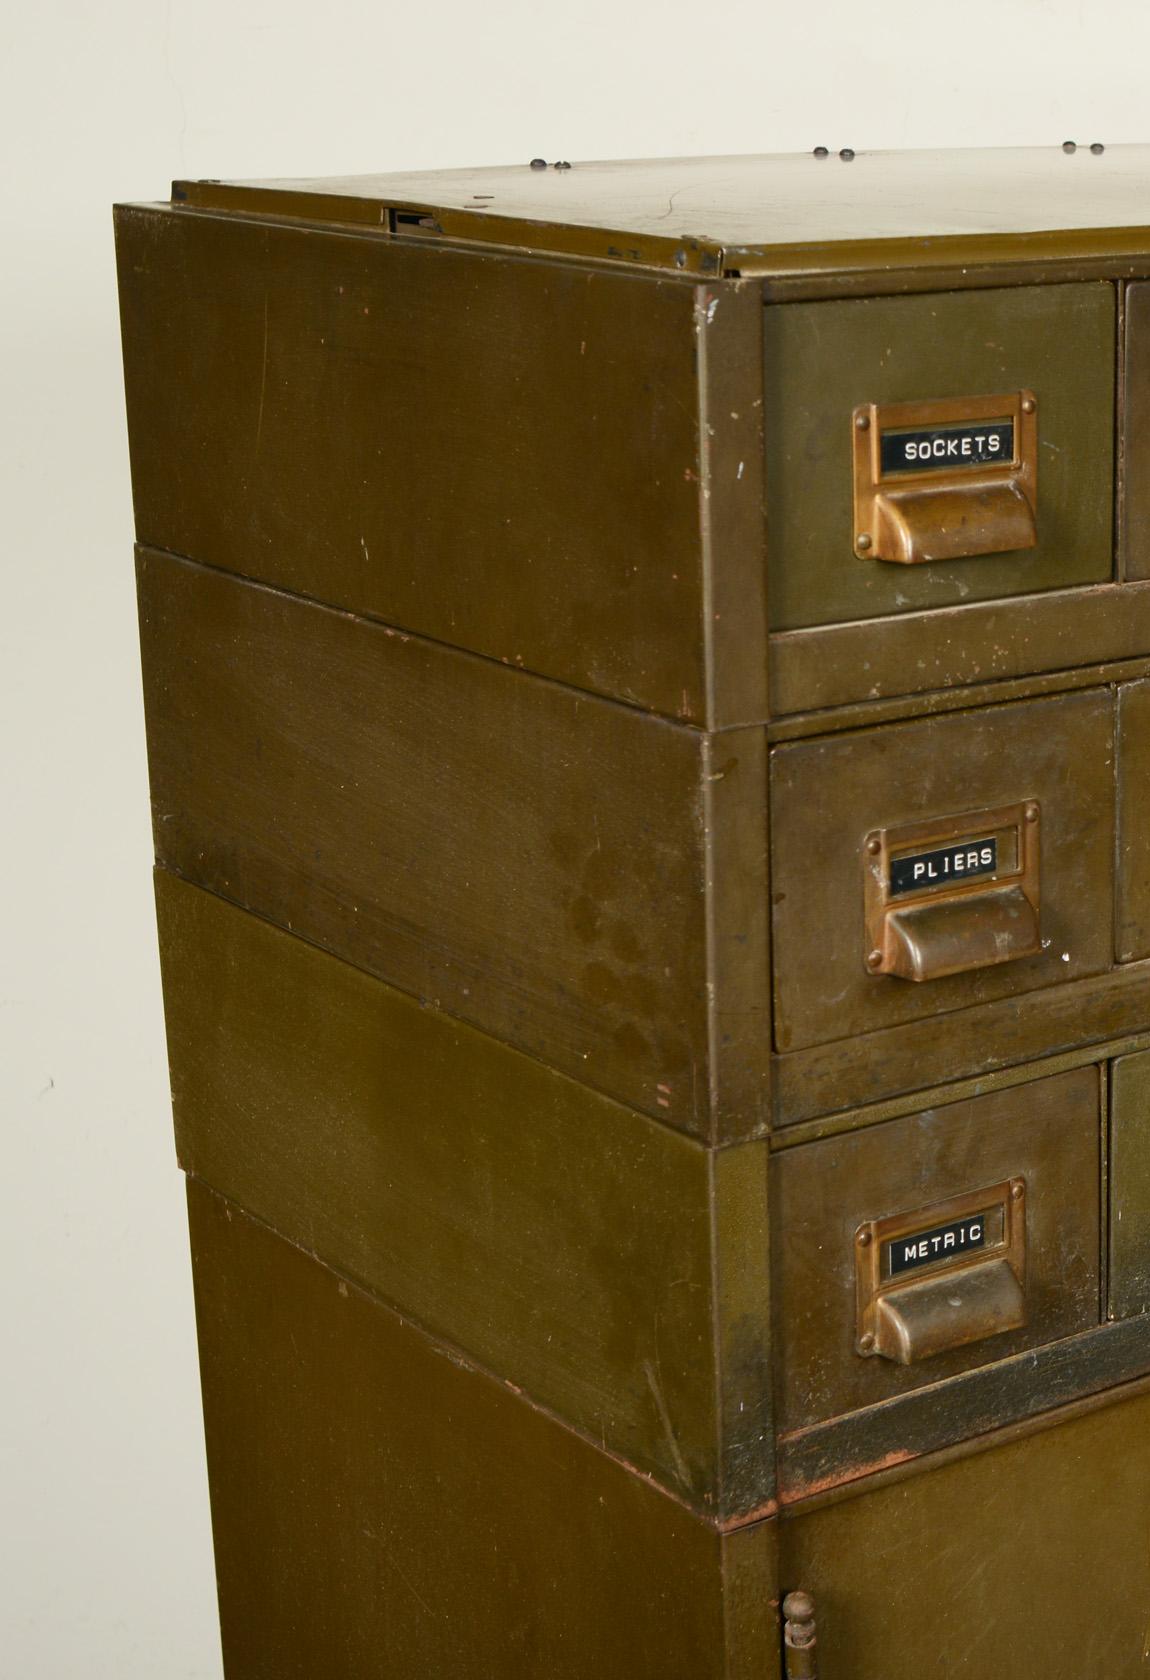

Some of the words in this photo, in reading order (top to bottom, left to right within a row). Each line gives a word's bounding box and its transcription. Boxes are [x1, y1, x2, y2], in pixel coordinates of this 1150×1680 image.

[904, 434, 1000, 460] SOCKETS
[913, 848, 992, 879] PLIERS
[904, 1224, 981, 1262] METRIC
